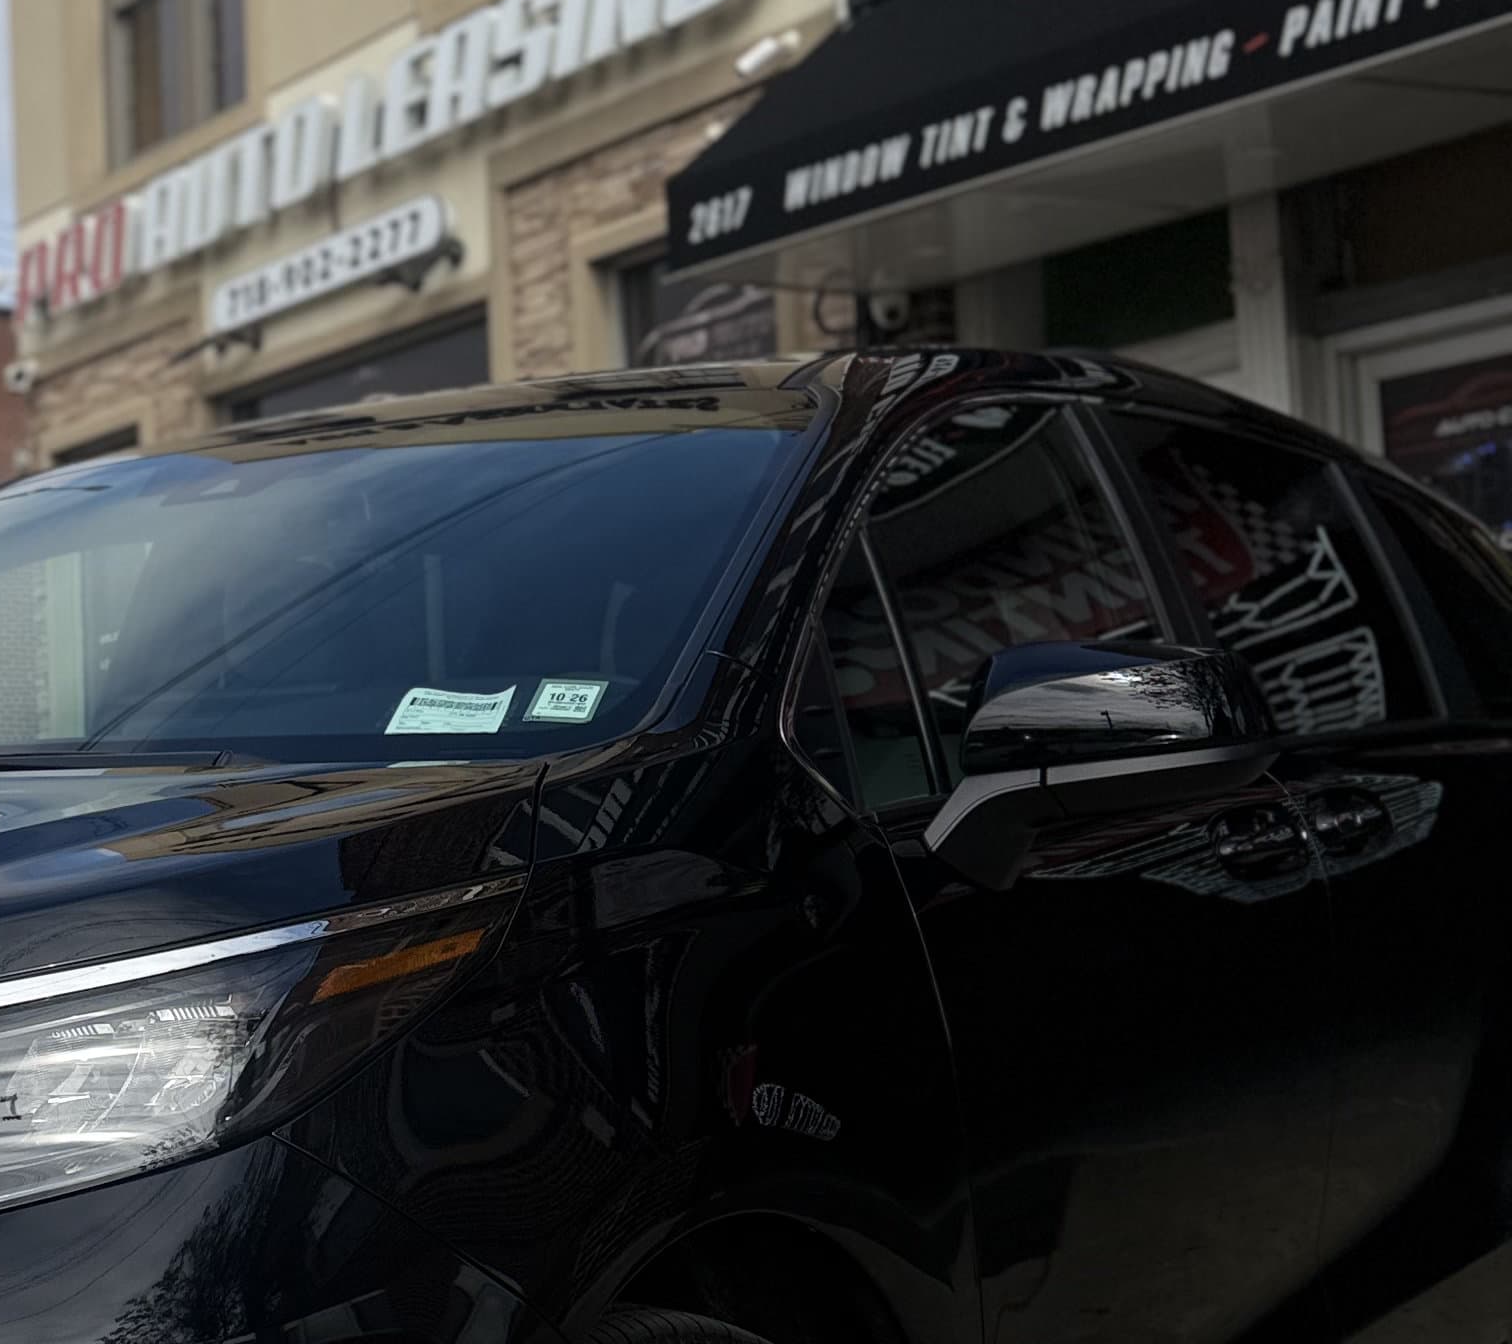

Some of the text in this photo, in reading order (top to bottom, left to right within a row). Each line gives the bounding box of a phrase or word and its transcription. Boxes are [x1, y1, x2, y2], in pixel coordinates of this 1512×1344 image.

[16, 197, 127, 322] PRO
[133, 94, 336, 274] AUTO
[783, 132, 912, 213] WINDOW
[918, 105, 996, 170] TINT
[1001, 95, 1029, 144] &
[1039, 28, 1236, 132] WRAPPING
[549, 692, 589, 703] 10 26
